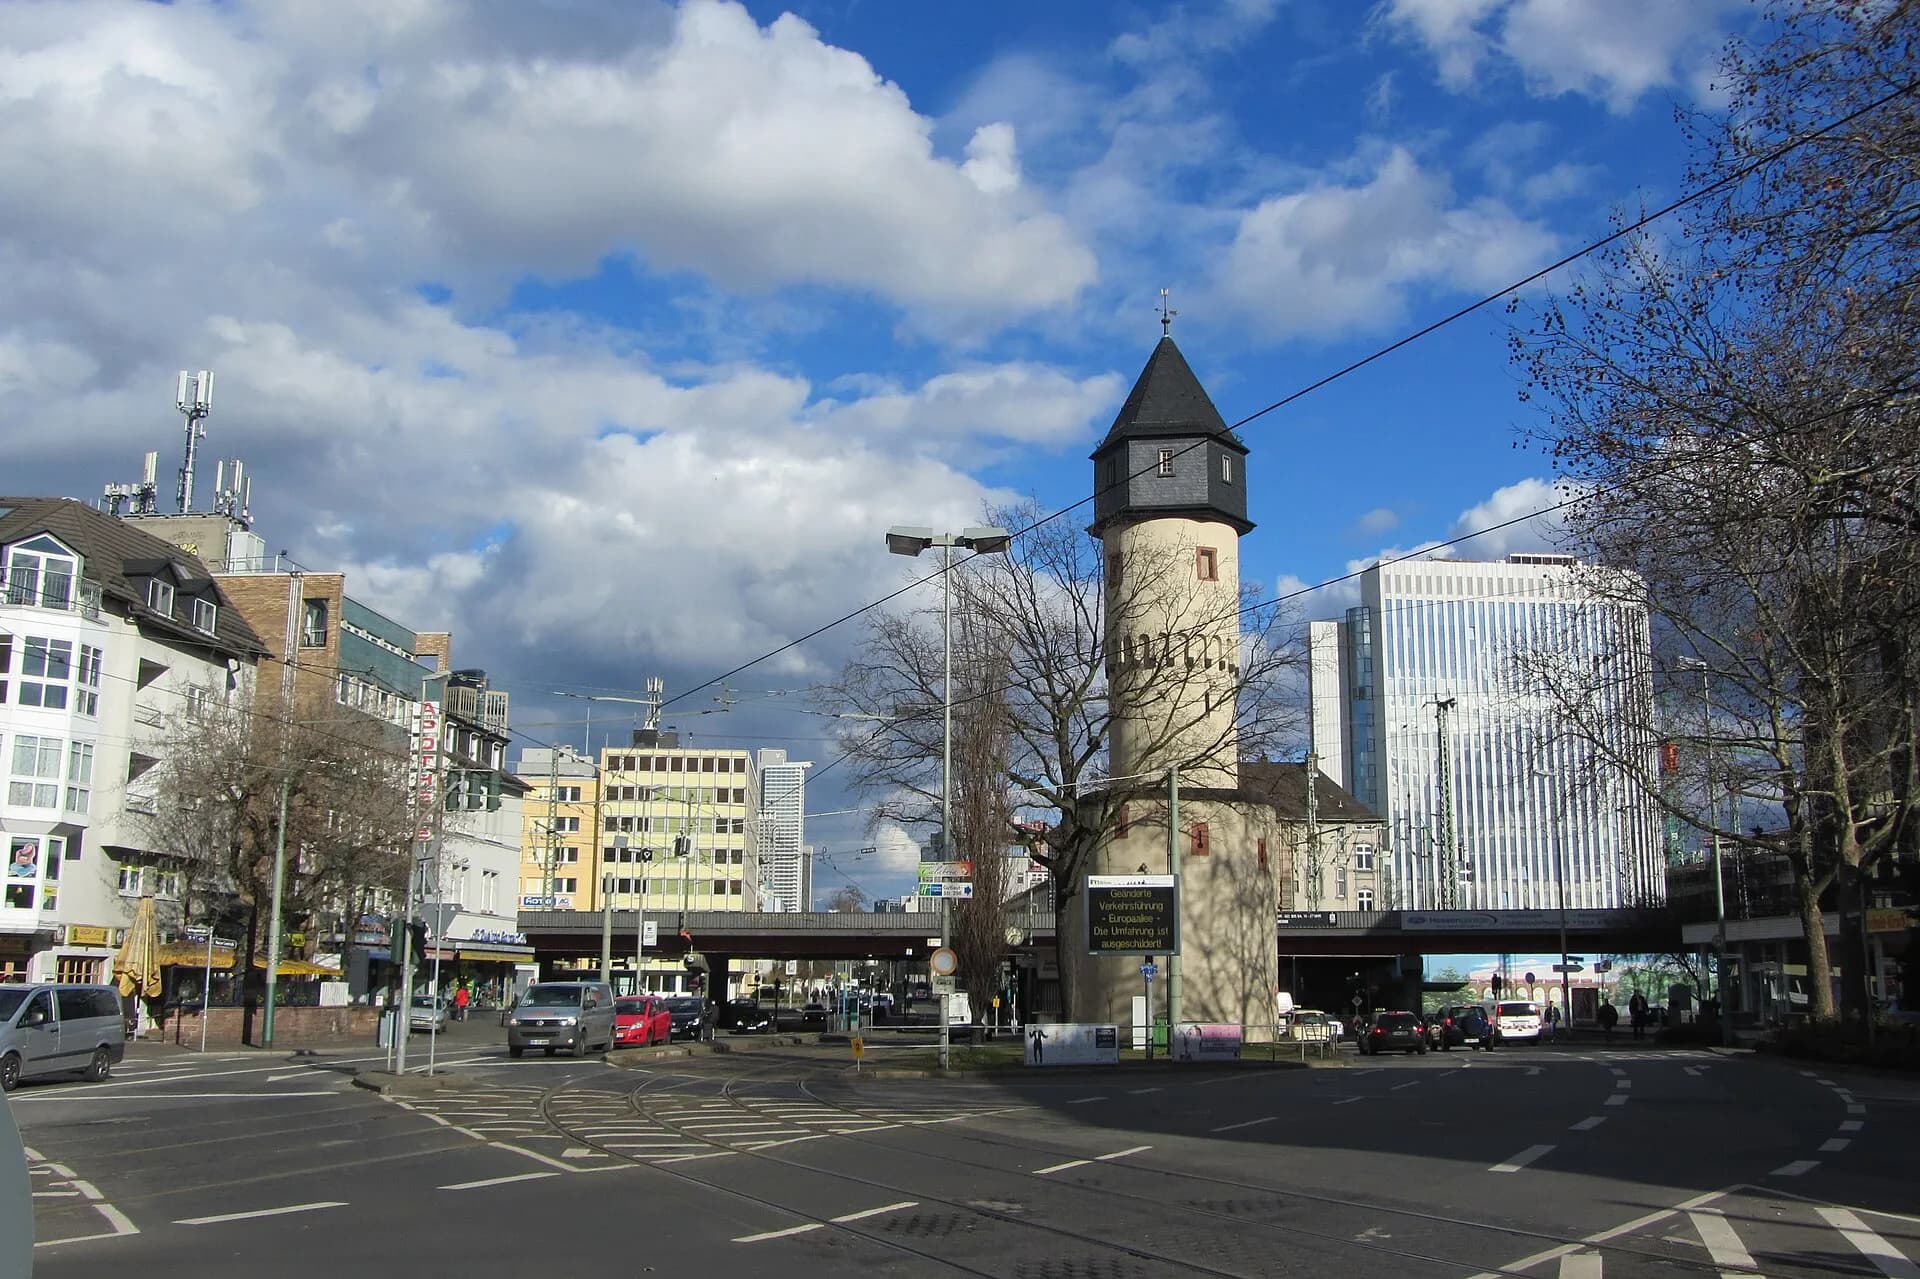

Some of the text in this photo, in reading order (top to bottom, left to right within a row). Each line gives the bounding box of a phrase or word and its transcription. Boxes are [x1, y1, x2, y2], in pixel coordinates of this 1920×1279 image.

[420, 702, 436, 841] APOTHEE
[1093, 926, 1109, 936] Die
[1111, 926, 1154, 938] Umfahrung
